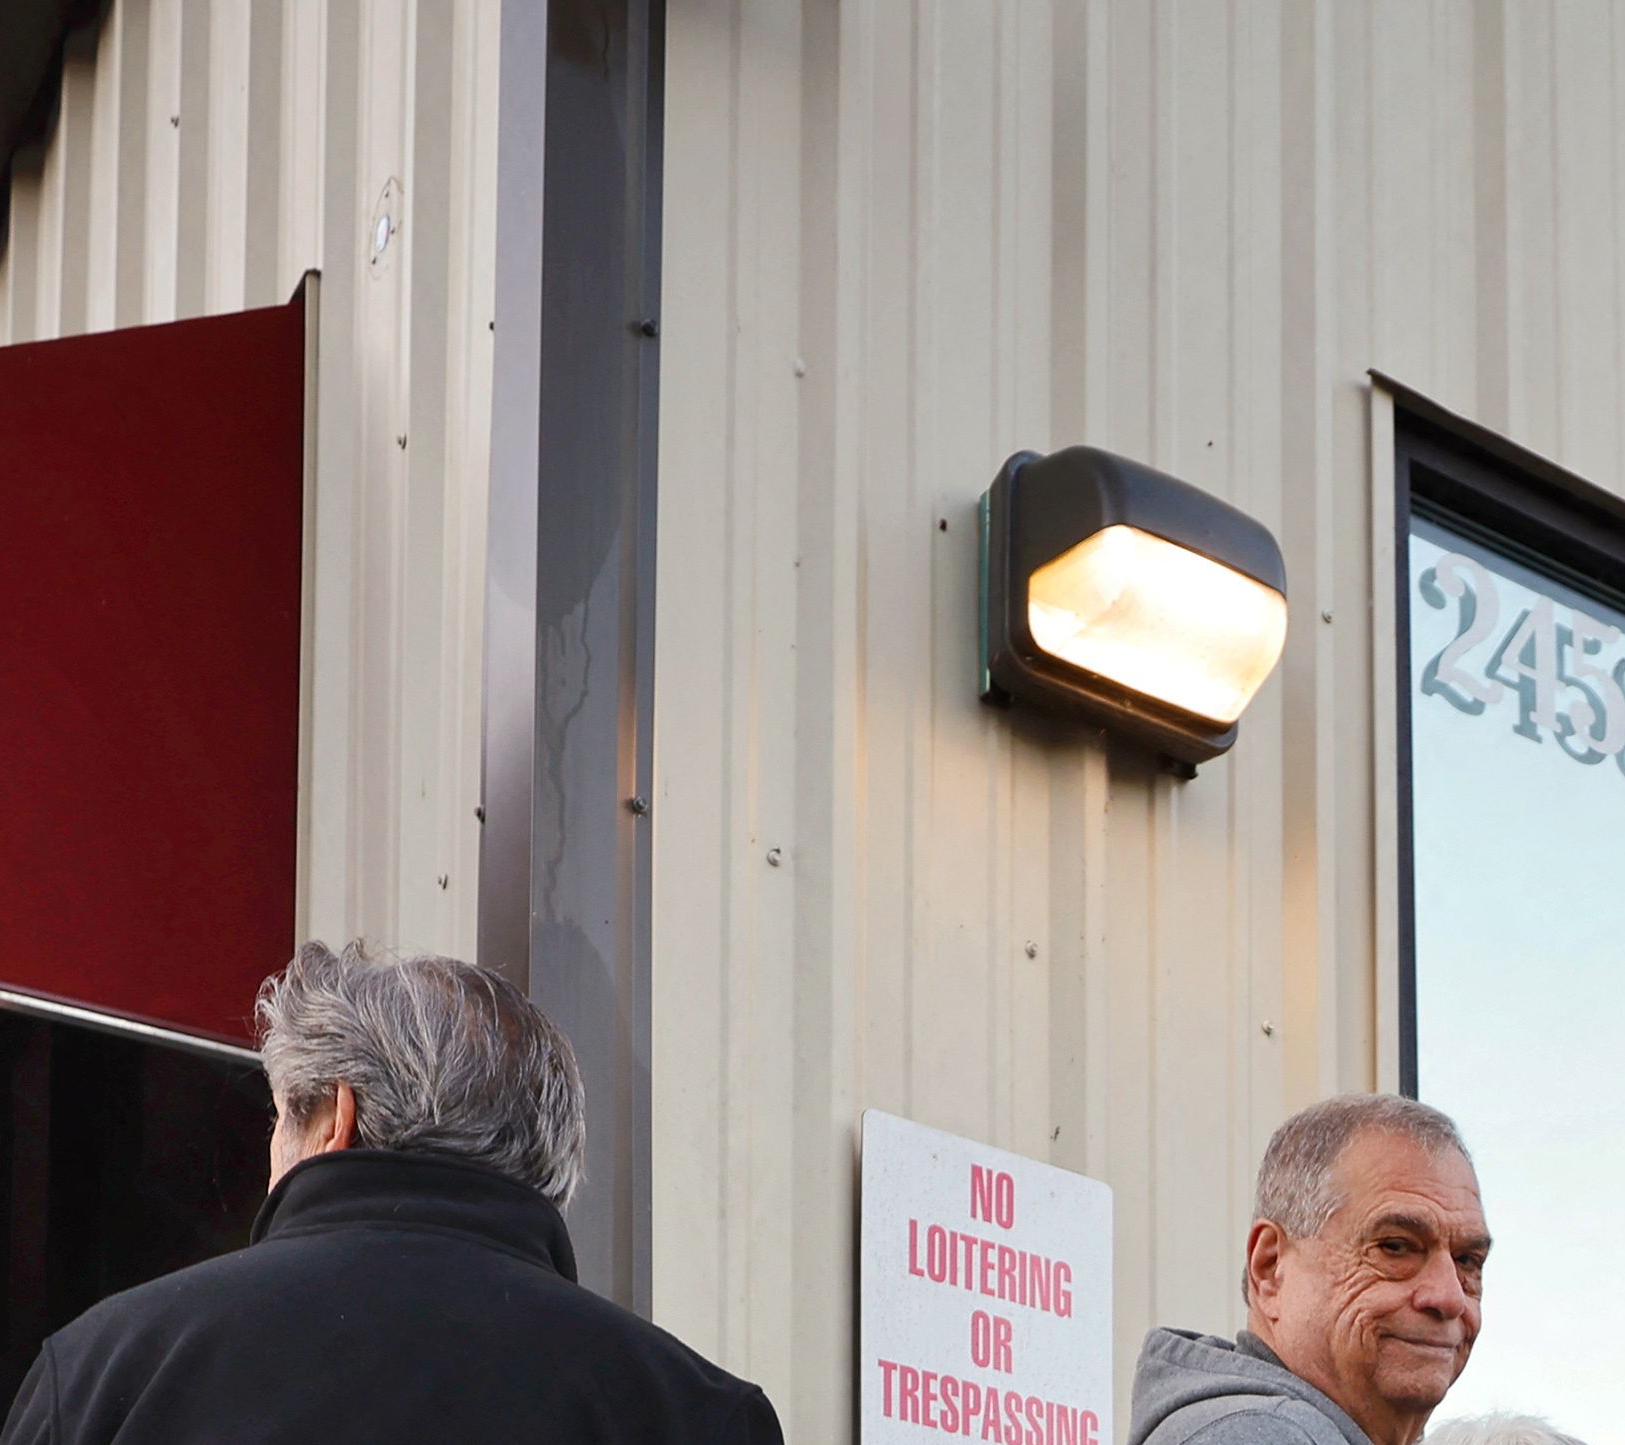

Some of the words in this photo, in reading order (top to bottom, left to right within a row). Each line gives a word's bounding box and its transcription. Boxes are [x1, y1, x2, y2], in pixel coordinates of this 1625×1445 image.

[969, 1162, 1015, 1230] NO
[907, 1218, 1073, 1319] LOITERING
[970, 1309, 1013, 1374] OR
